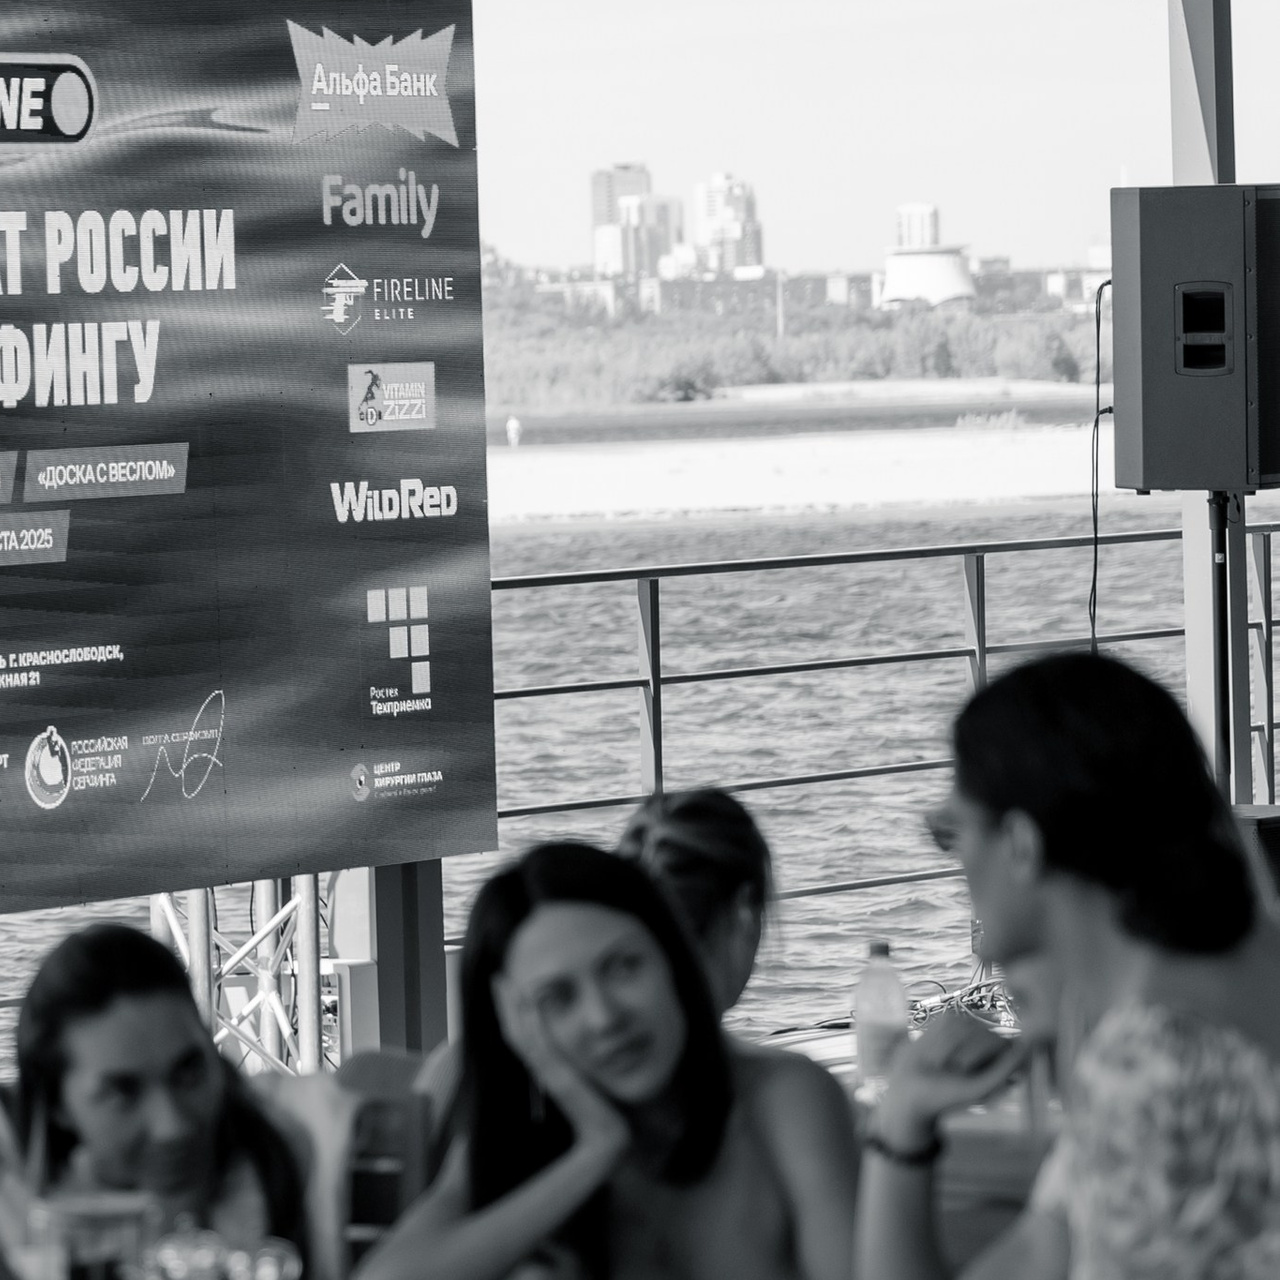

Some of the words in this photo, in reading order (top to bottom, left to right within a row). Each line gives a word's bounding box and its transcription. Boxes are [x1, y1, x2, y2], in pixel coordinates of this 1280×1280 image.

[311, 63, 382, 105] Альфа
[385, 64, 438, 96] Банк
[322, 167, 439, 238] Family
[45, 209, 237, 294] РОССИИ
[374, 278, 454, 302] FIRELINE
[375, 308, 415, 319] ELITE
[382, 382, 426, 399] VITAMIN
[37, 464, 94, 490] «ДОСКА
[96, 465, 108, 486] С
[108, 460, 176, 484] ВЕСЛОМ»
[20, 528, 53, 550] 2025
[9, 653, 18, 668] Г.
[18, 644, 125, 668] КРАСНОСЛОБОДСК,
[28, 671, 41, 686] 21
